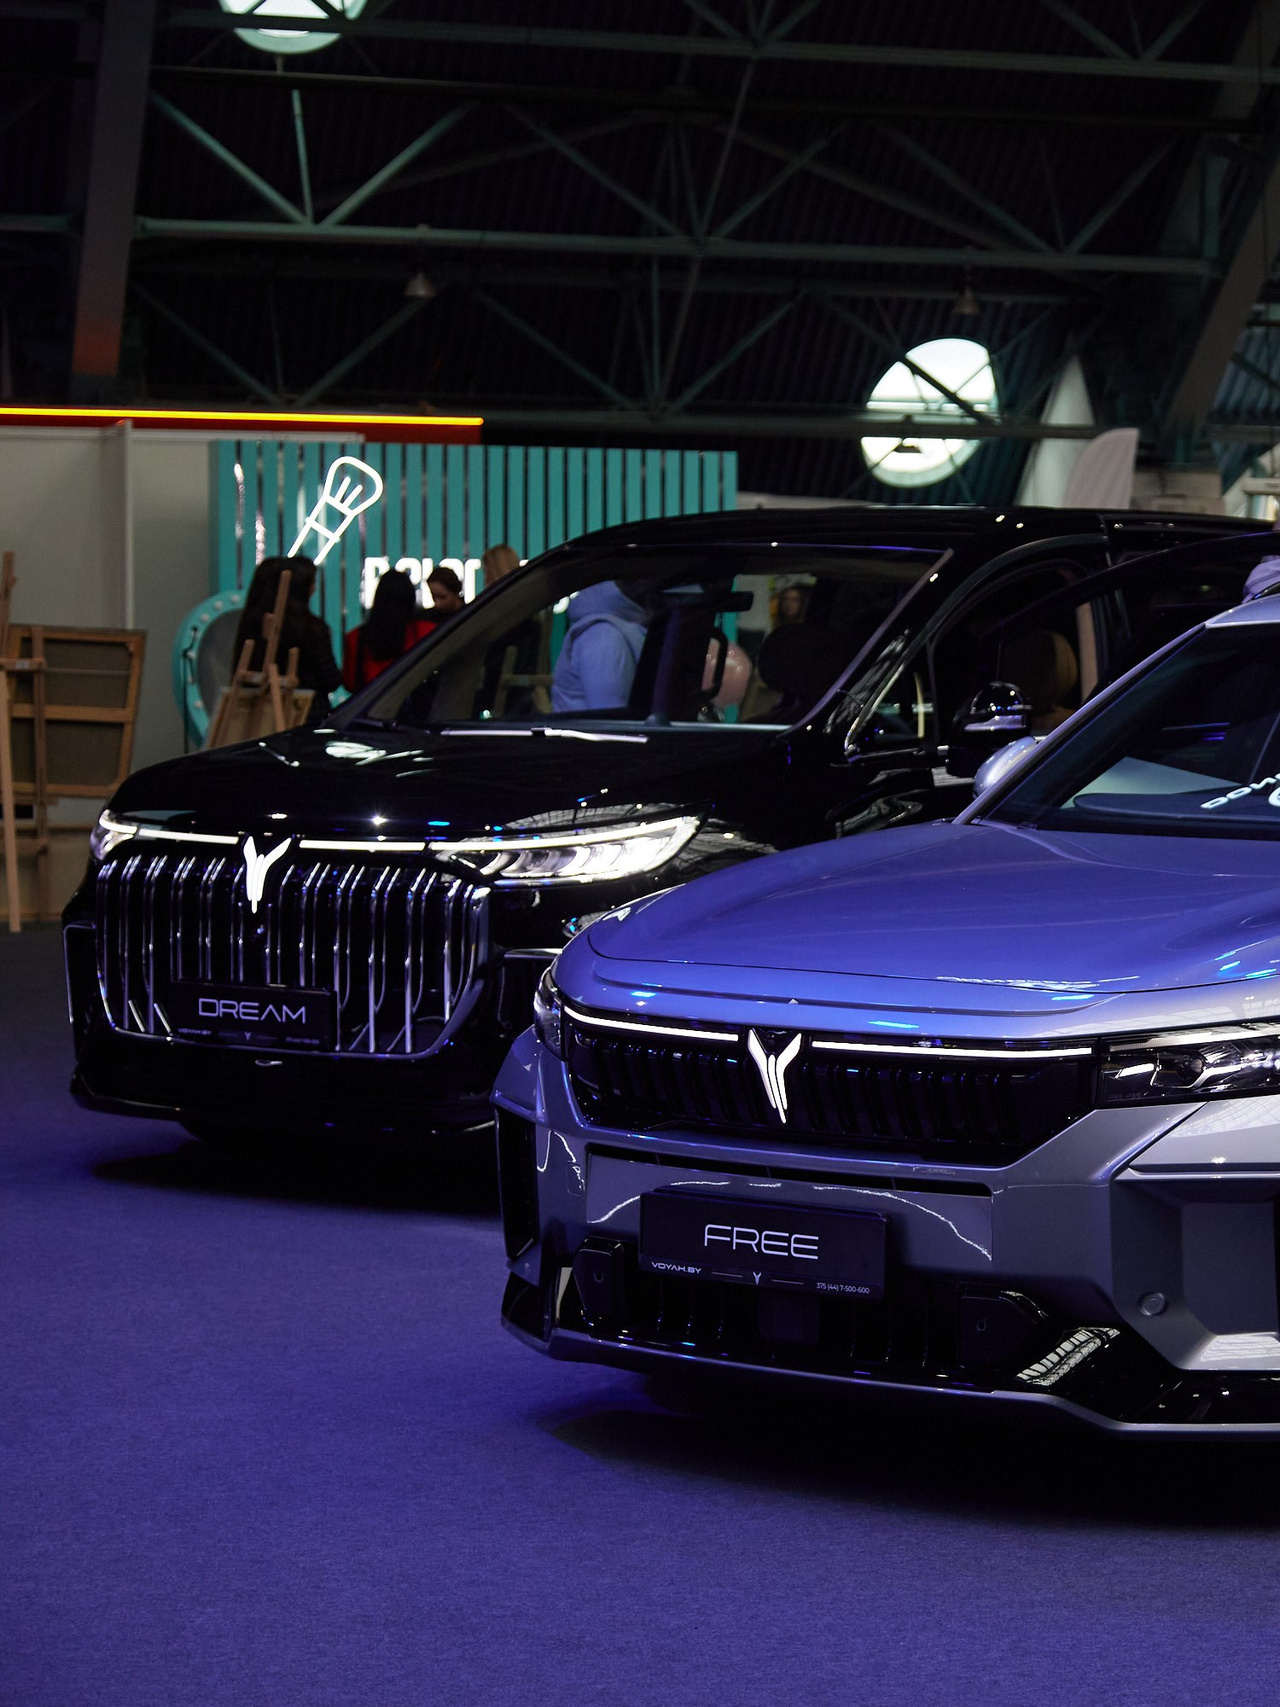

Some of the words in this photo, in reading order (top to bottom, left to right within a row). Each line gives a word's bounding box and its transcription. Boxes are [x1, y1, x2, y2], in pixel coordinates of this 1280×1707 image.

[198, 997, 307, 1025] DREAM
[704, 1223, 819, 1260] FREE
[651, 1261, 702, 1274] VOYAH.BY
